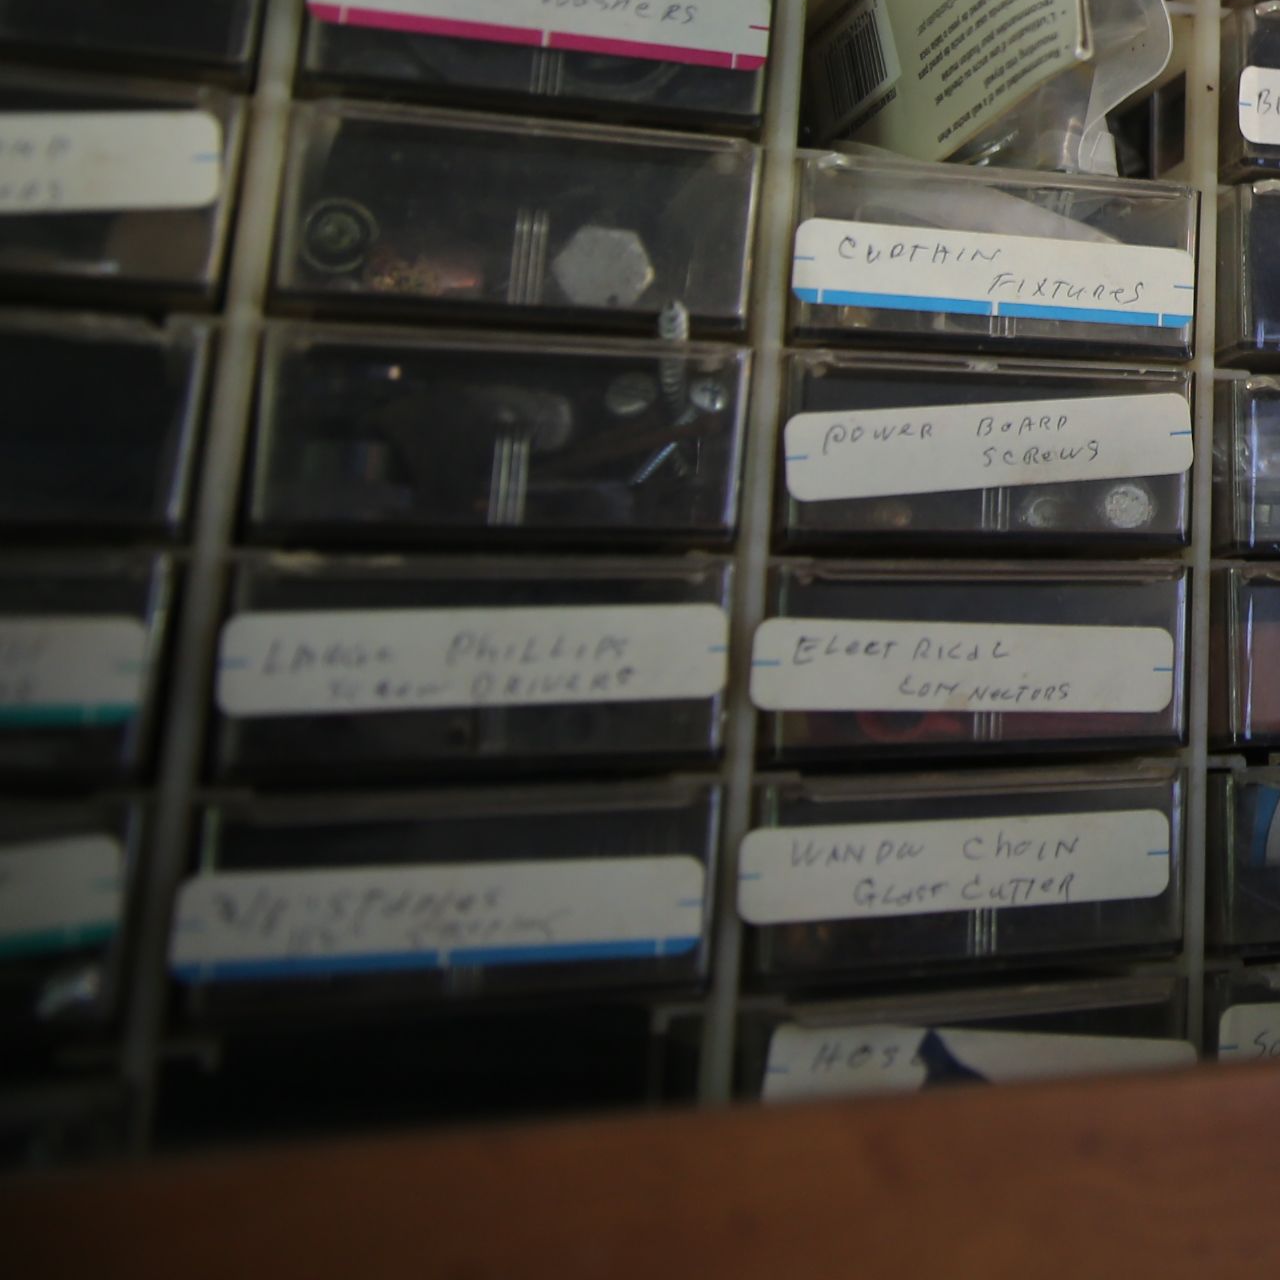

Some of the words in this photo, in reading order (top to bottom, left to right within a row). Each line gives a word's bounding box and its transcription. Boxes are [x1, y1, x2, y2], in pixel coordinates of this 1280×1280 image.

[1018, 31, 1057, 59] mounting
[983, 65, 1004, 88] drywall
[1006, 48, 1059, 88] Recommended
[971, 102, 982, 116] wall
[951, 112, 970, 131] anchor
[937, 127, 951, 143] when
